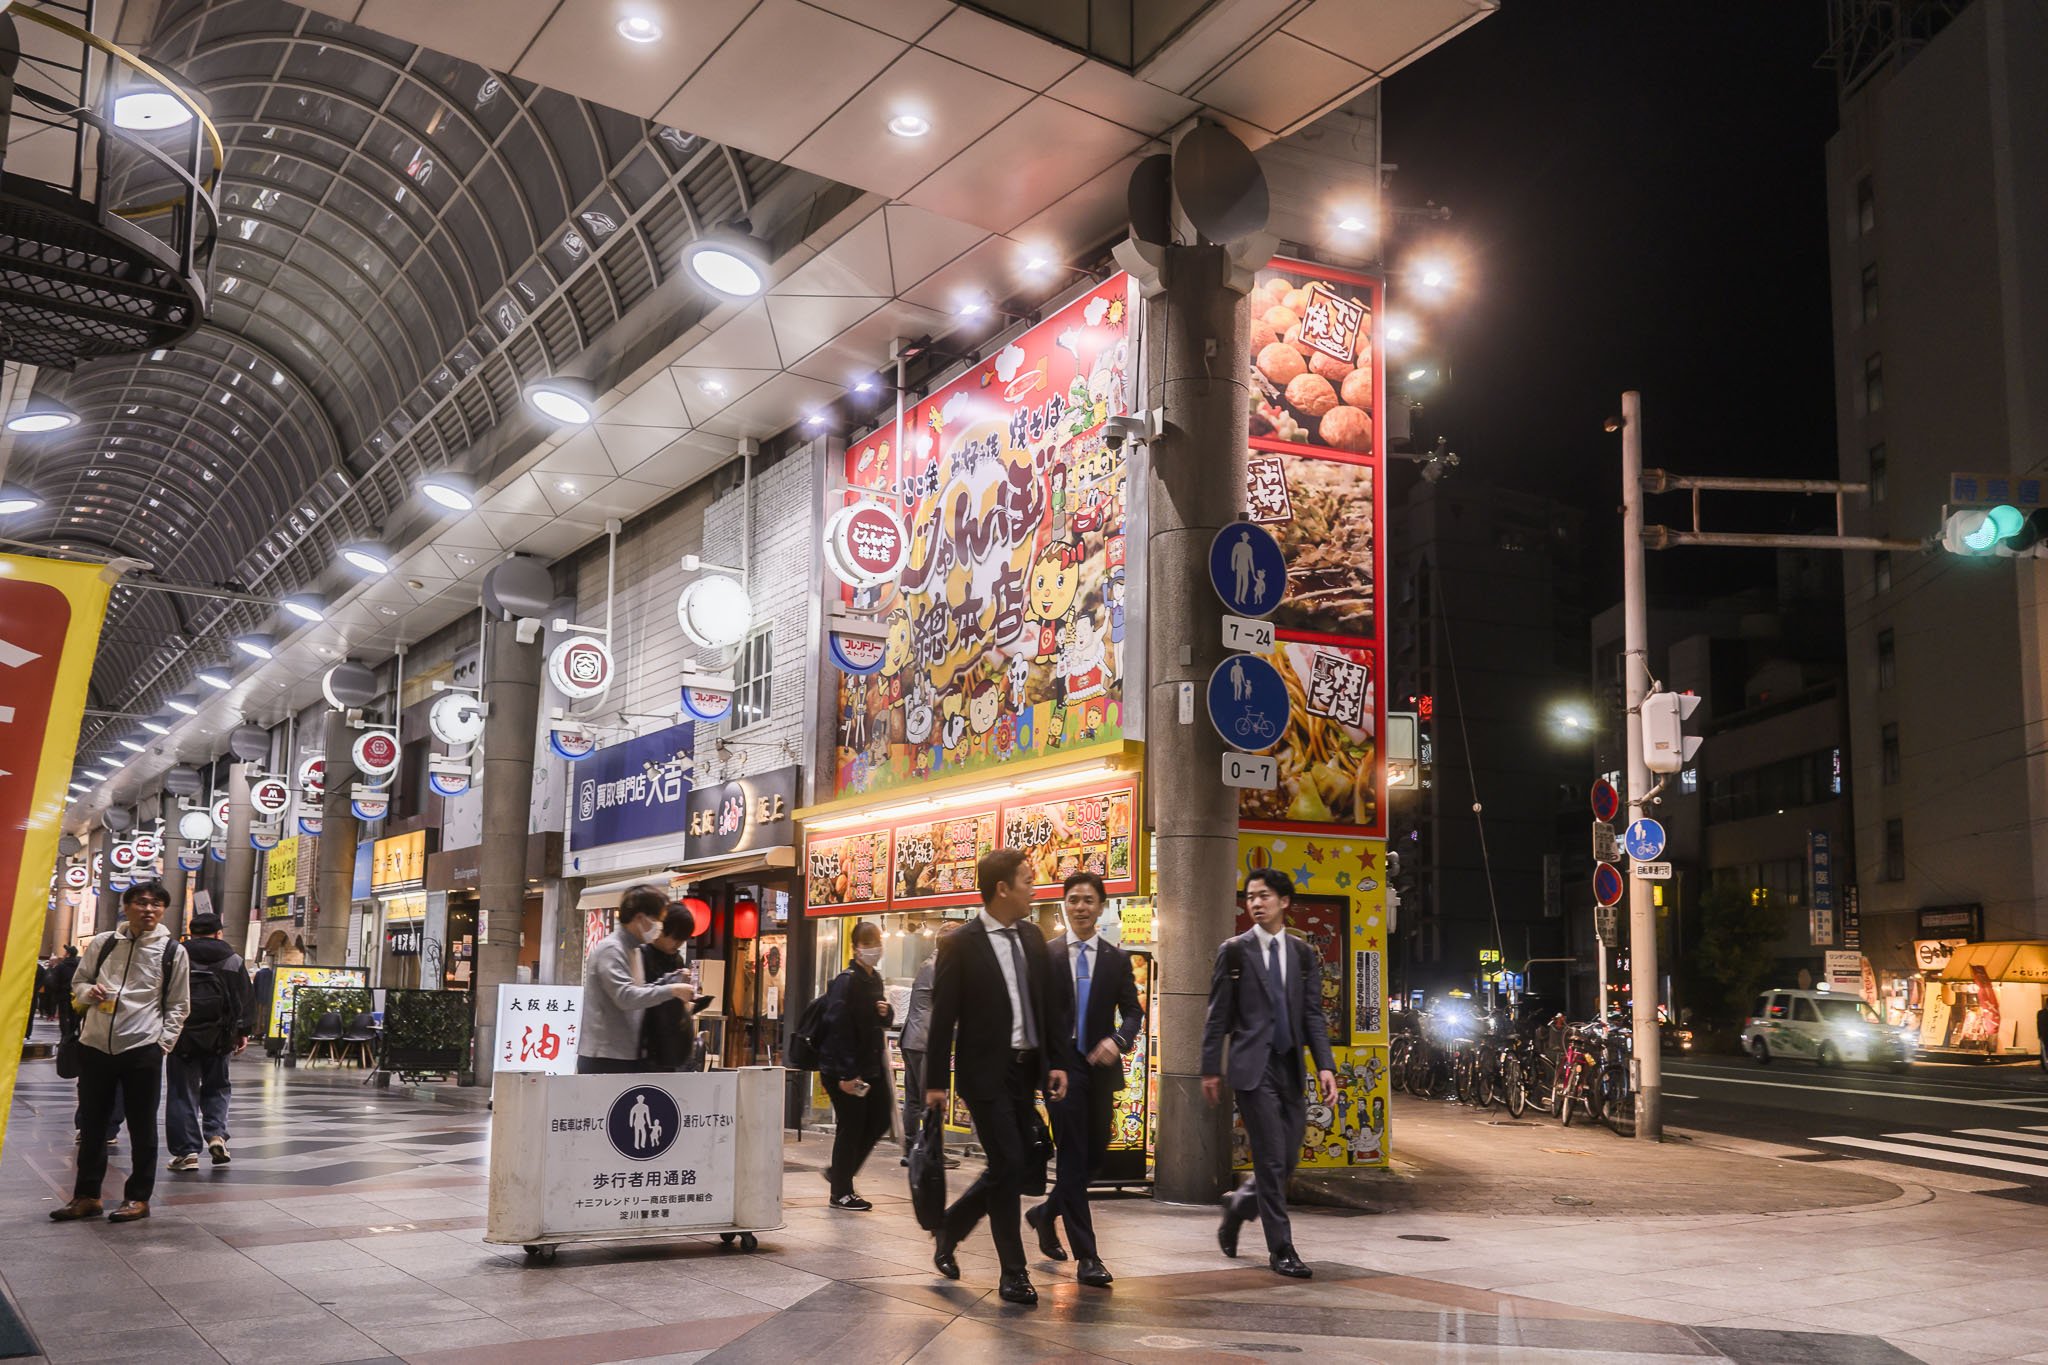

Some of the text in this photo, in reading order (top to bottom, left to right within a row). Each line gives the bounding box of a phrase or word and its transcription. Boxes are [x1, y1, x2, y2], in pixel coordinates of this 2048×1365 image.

[1010, 392, 1066, 450] 焼そば
[1230, 761, 1270, 782] 0-7
[510, 998, 576, 1012] 大阪極上
[520, 1023, 561, 1062] 油
[552, 1114, 734, 1133] 自転車は押して 通行して下さい
[593, 1169, 697, 1190] 歩行者用通路
[575, 1192, 713, 1208] 十三フレンドリー商店街振興組合
